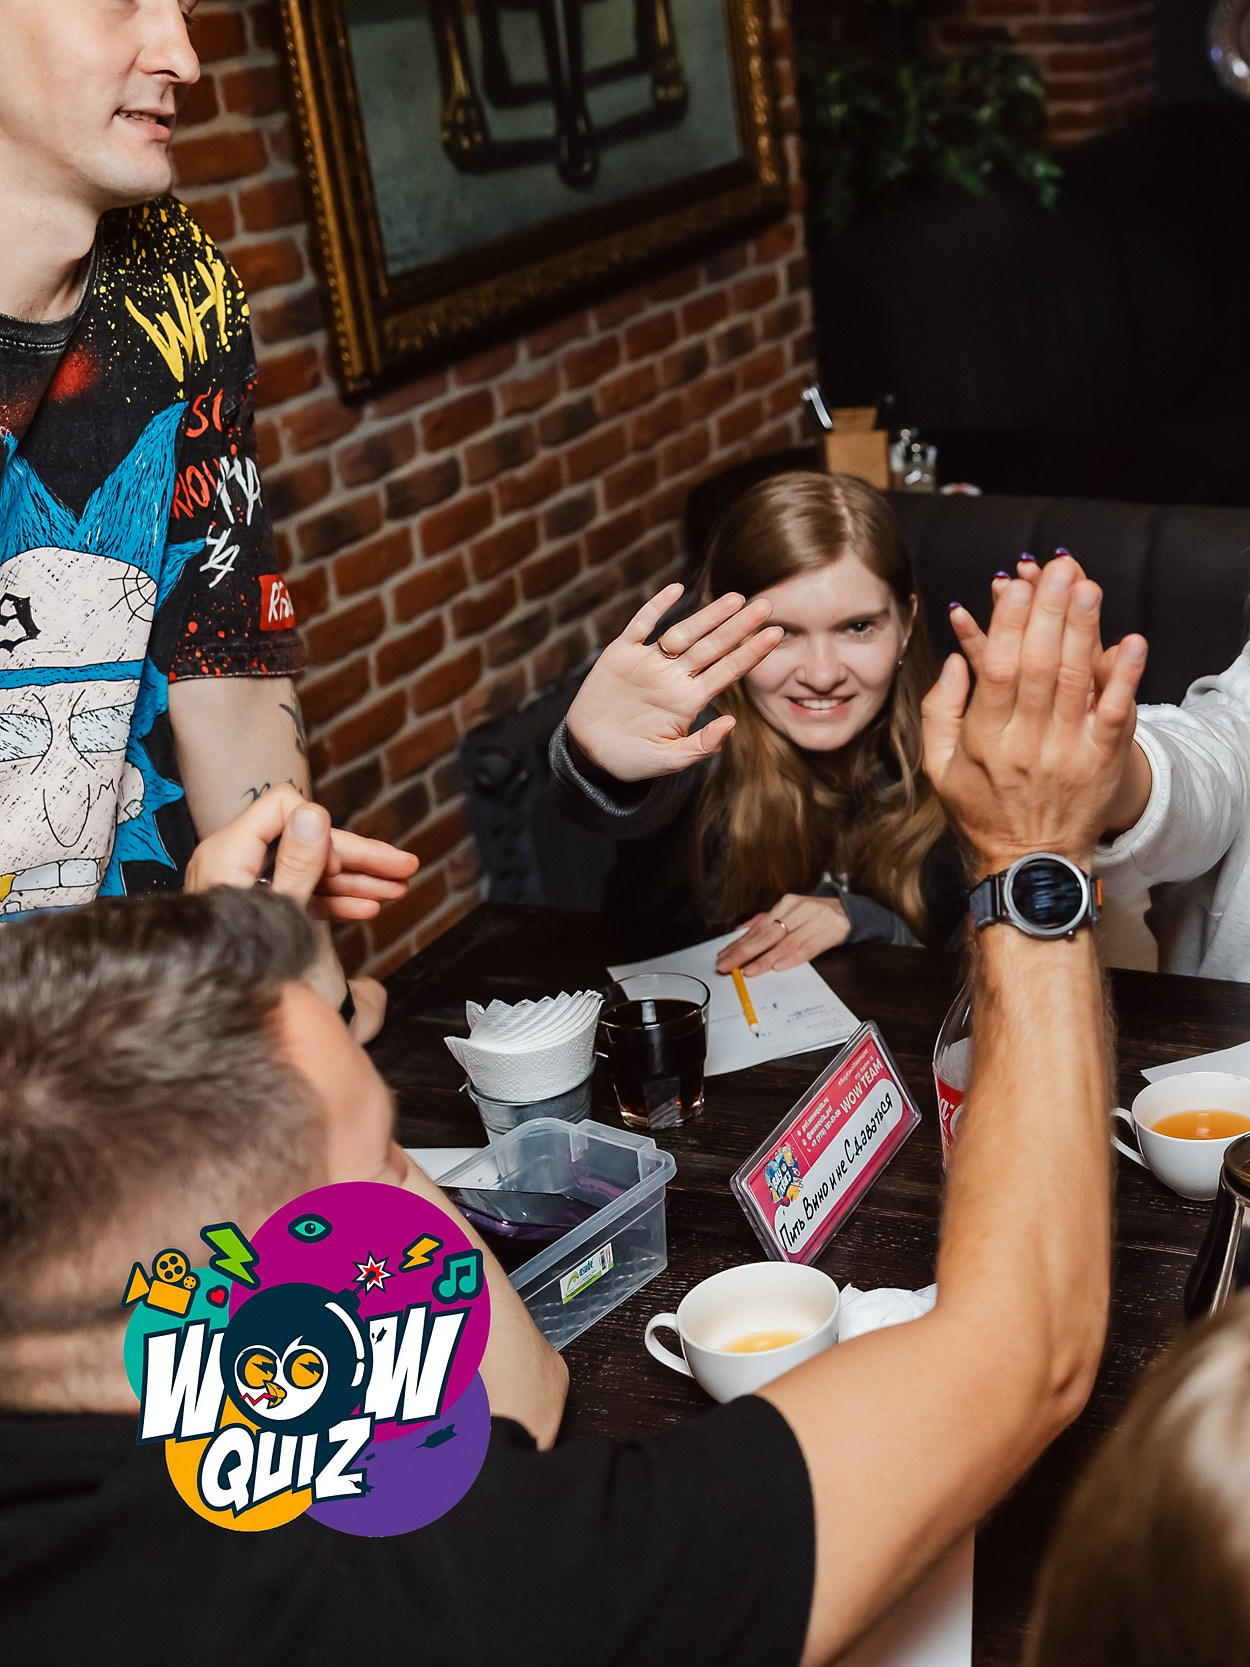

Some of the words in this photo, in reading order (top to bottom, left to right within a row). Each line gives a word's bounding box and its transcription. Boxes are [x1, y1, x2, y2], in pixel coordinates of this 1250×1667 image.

[840, 1081, 863, 1114] WOW
[860, 1057, 883, 1088] TEAM
[779, 1218, 806, 1251] Пить
[803, 1182, 829, 1221] Вино
[836, 1160, 848, 1182] не
[844, 1091, 893, 1164] Сдаваться
